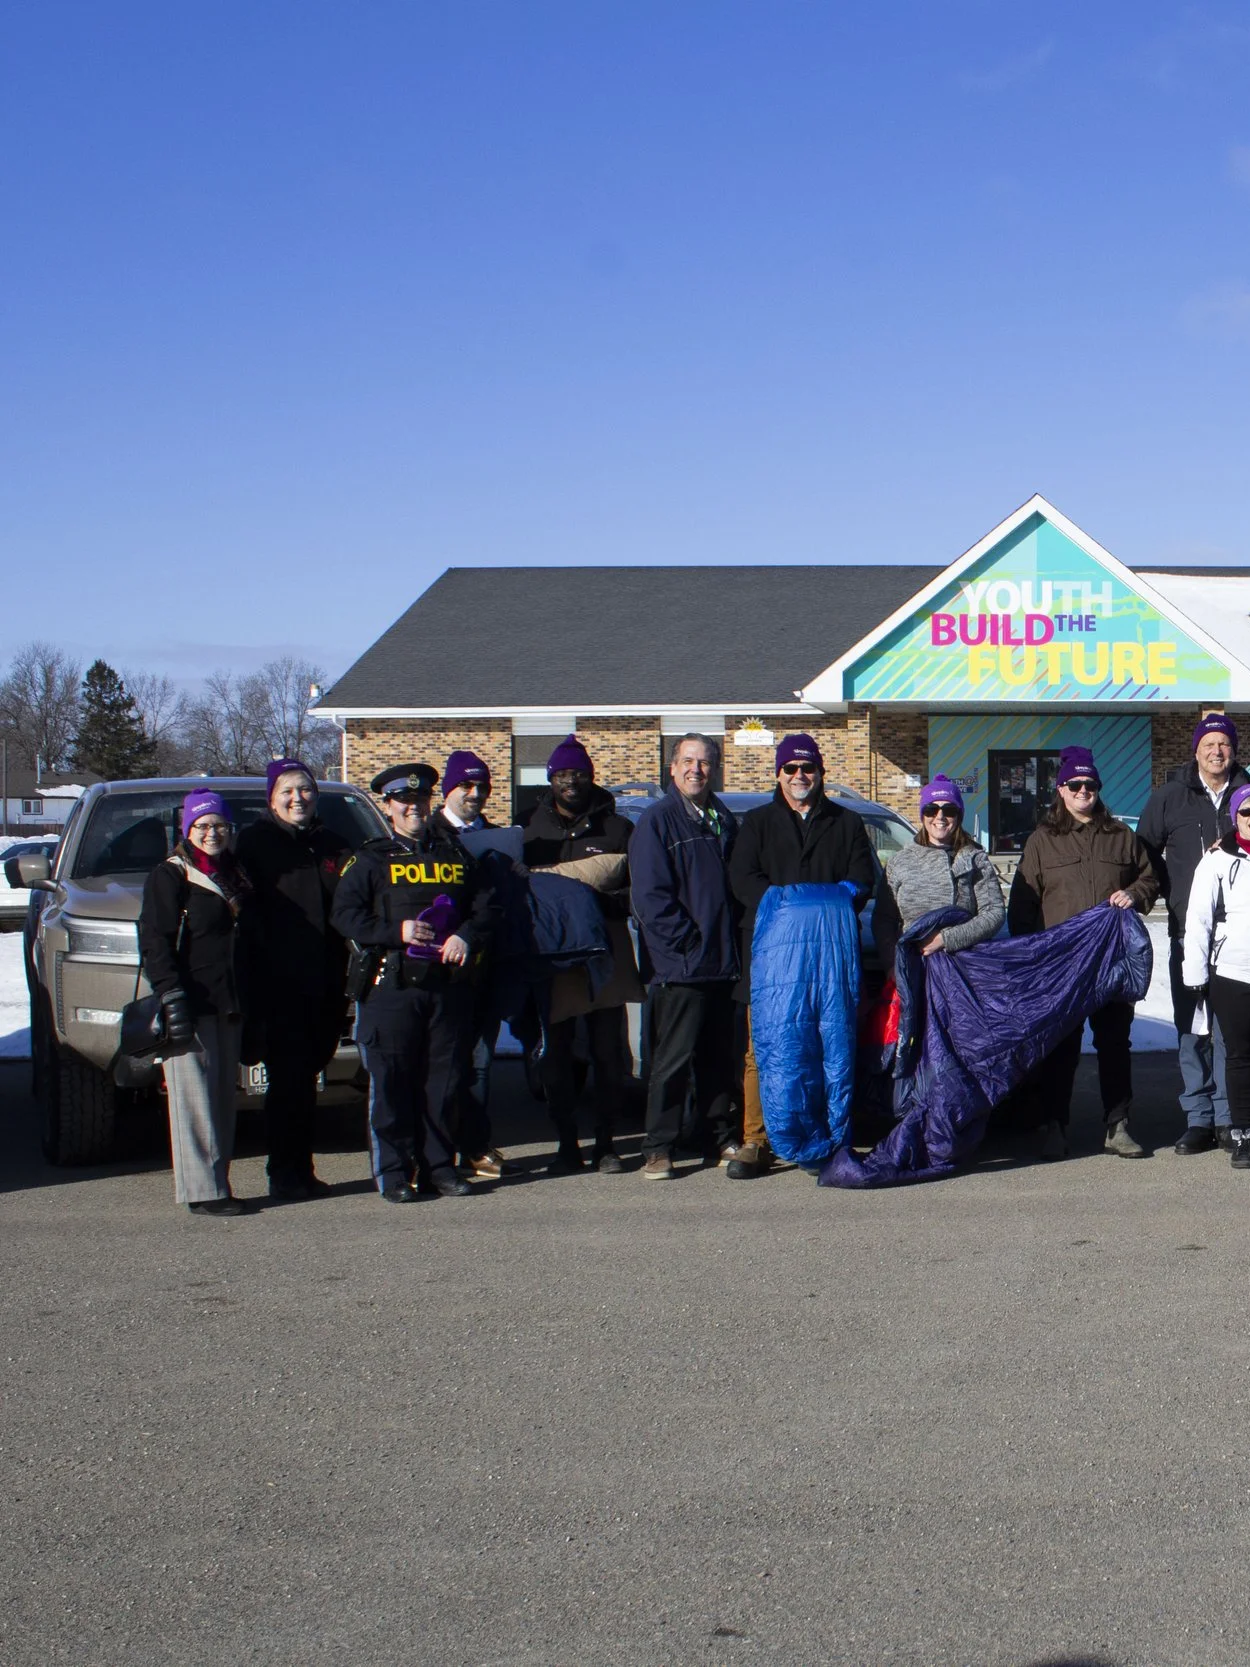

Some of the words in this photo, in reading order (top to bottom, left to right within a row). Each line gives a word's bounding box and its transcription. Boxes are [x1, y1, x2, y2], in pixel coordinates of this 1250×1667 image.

[959, 580, 1113, 618] YOUTH
[931, 613, 1055, 647] BUILD
[1055, 614, 1096, 632] THE
[968, 641, 1177, 686] FUTURE
[390, 863, 464, 884] POLICE
